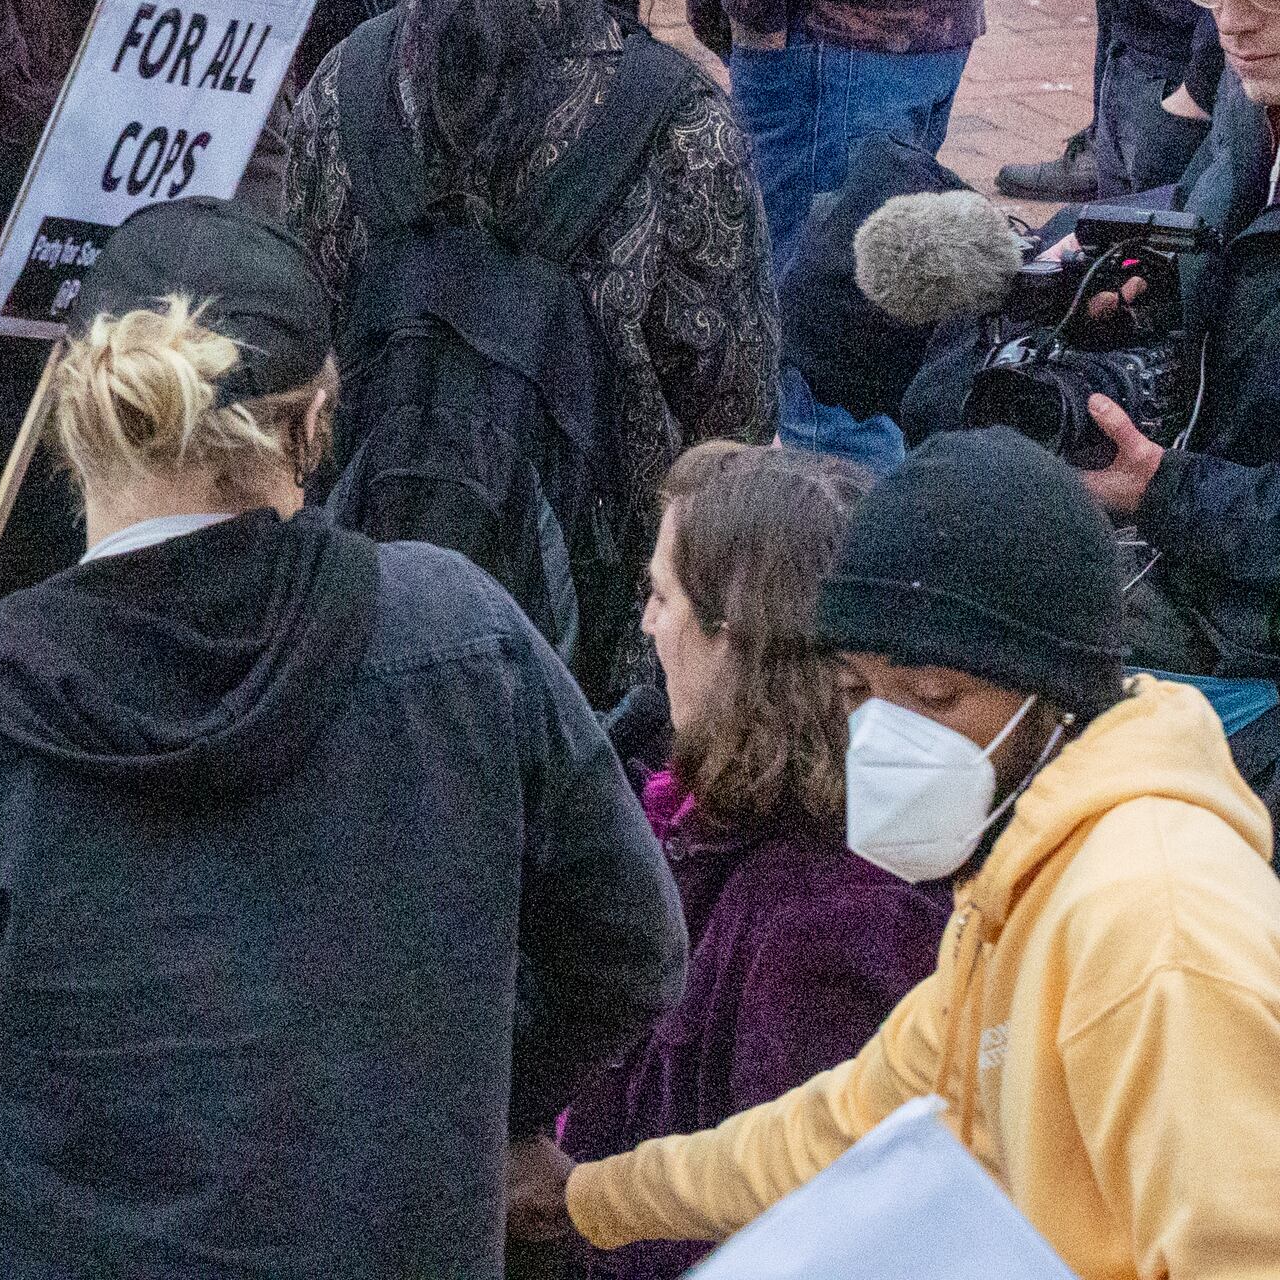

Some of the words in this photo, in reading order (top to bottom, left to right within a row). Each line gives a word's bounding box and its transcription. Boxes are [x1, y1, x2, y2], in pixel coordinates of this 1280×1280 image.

[111, 2, 208, 87] FOR
[197, 19, 273, 94] ALL
[101, 121, 211, 200] COPS
